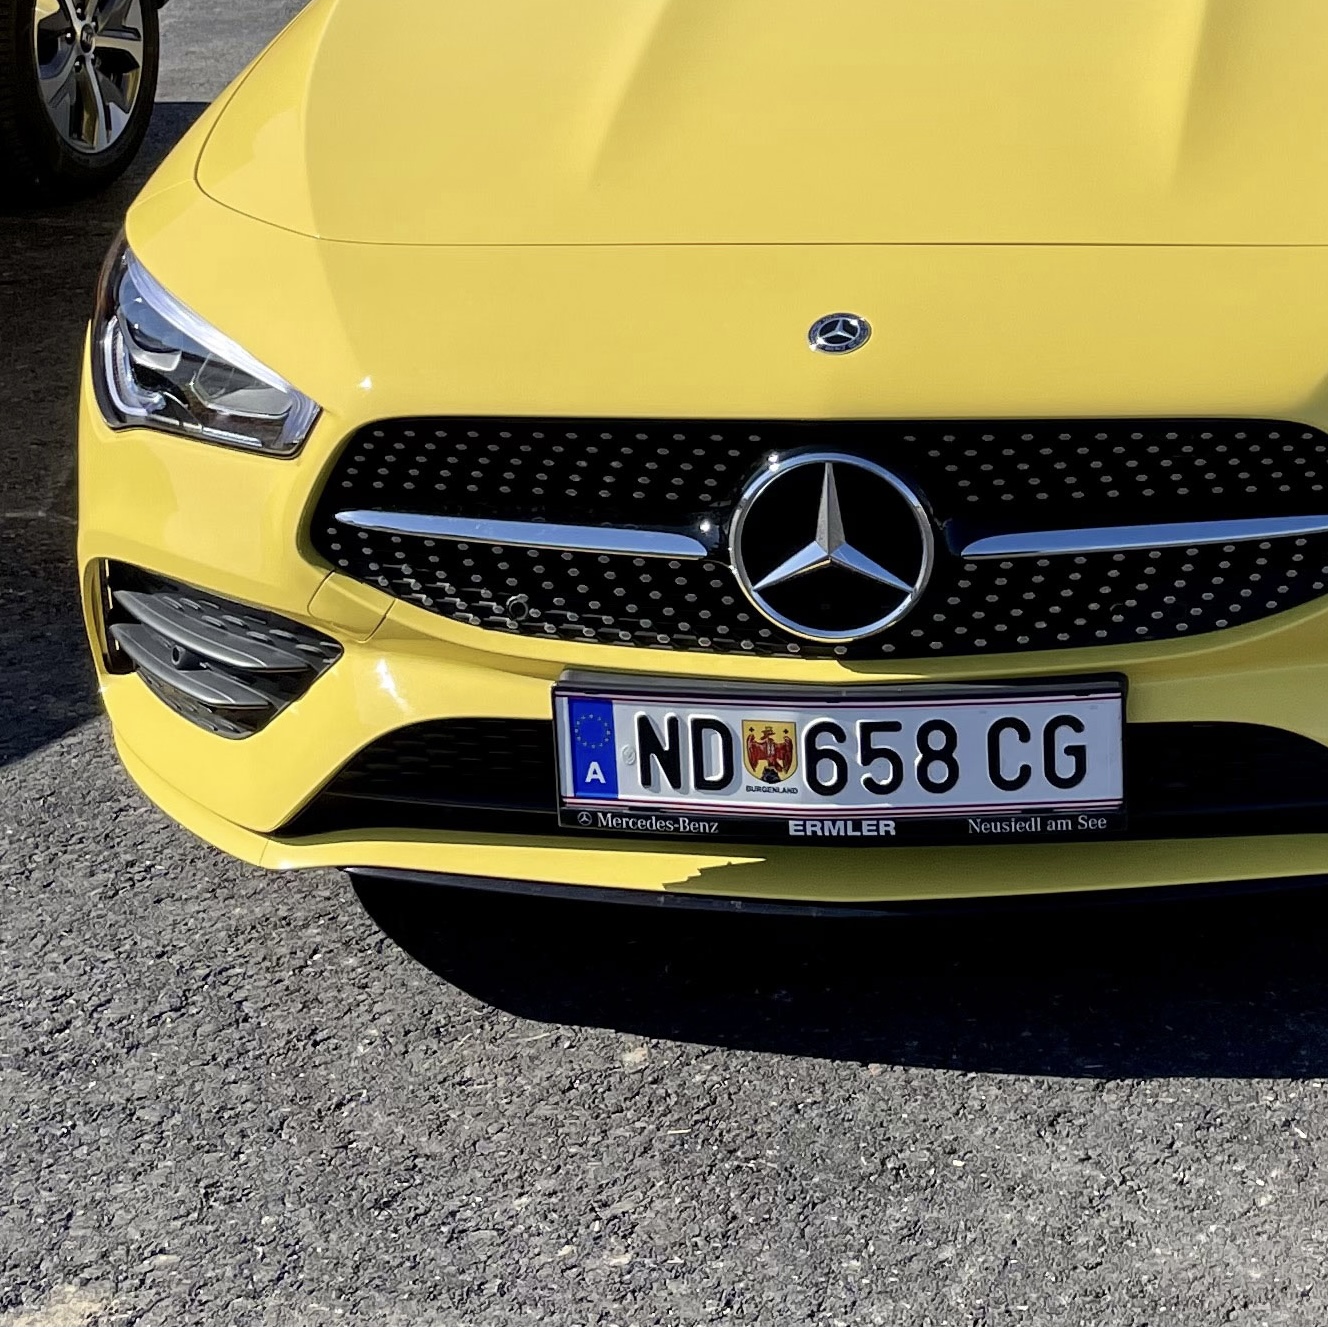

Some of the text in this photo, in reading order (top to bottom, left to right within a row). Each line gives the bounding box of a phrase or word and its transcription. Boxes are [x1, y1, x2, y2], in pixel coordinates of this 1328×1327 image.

[636, 711, 1088, 796] ND 658 CG
[585, 761, 606, 784] A
[745, 784, 798, 794] BURGENLAND
[597, 812, 719, 834] Mercedes-Benz
[788, 819, 896, 836] ERMLER
[968, 814, 1107, 834] Neusiedl am See
